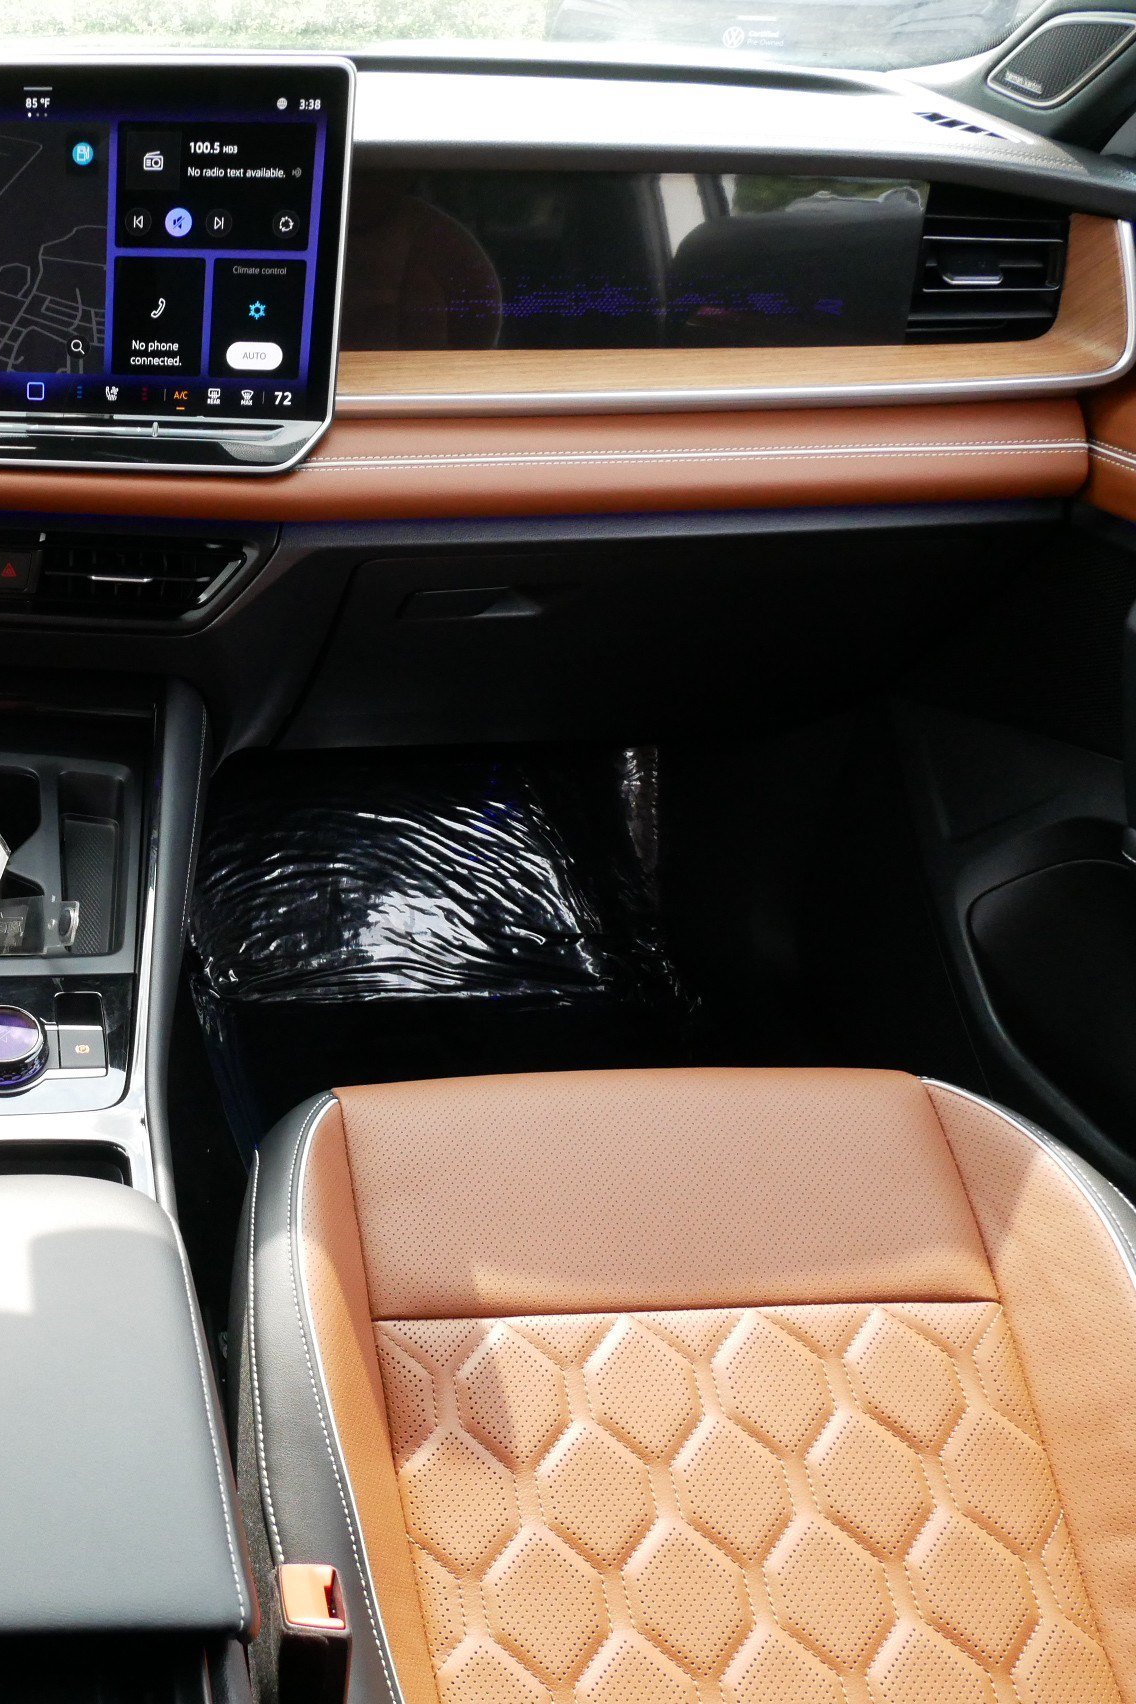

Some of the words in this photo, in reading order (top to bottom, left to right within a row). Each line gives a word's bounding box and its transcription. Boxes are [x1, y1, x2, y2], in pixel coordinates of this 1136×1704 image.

[749, 30, 779, 38] Certified
[25, 97, 38, 109] 85
[299, 98, 321, 110] 3:38
[189, 141, 220, 154] 100.5
[222, 145, 238, 154] HD3
[187, 166, 201, 177] No
[202, 167, 225, 177] radio
[227, 168, 244, 177] text
[246, 167, 286, 178] available.
[232, 265, 260, 275] Climate
[261, 267, 287, 275] control
[132, 339, 146, 350] No
[148, 340, 179, 352] phone
[130, 355, 182, 366] connected.
[242, 351, 267, 360] AUTO
[173, 390, 189, 400] A/C
[274, 391, 292, 406] 72
